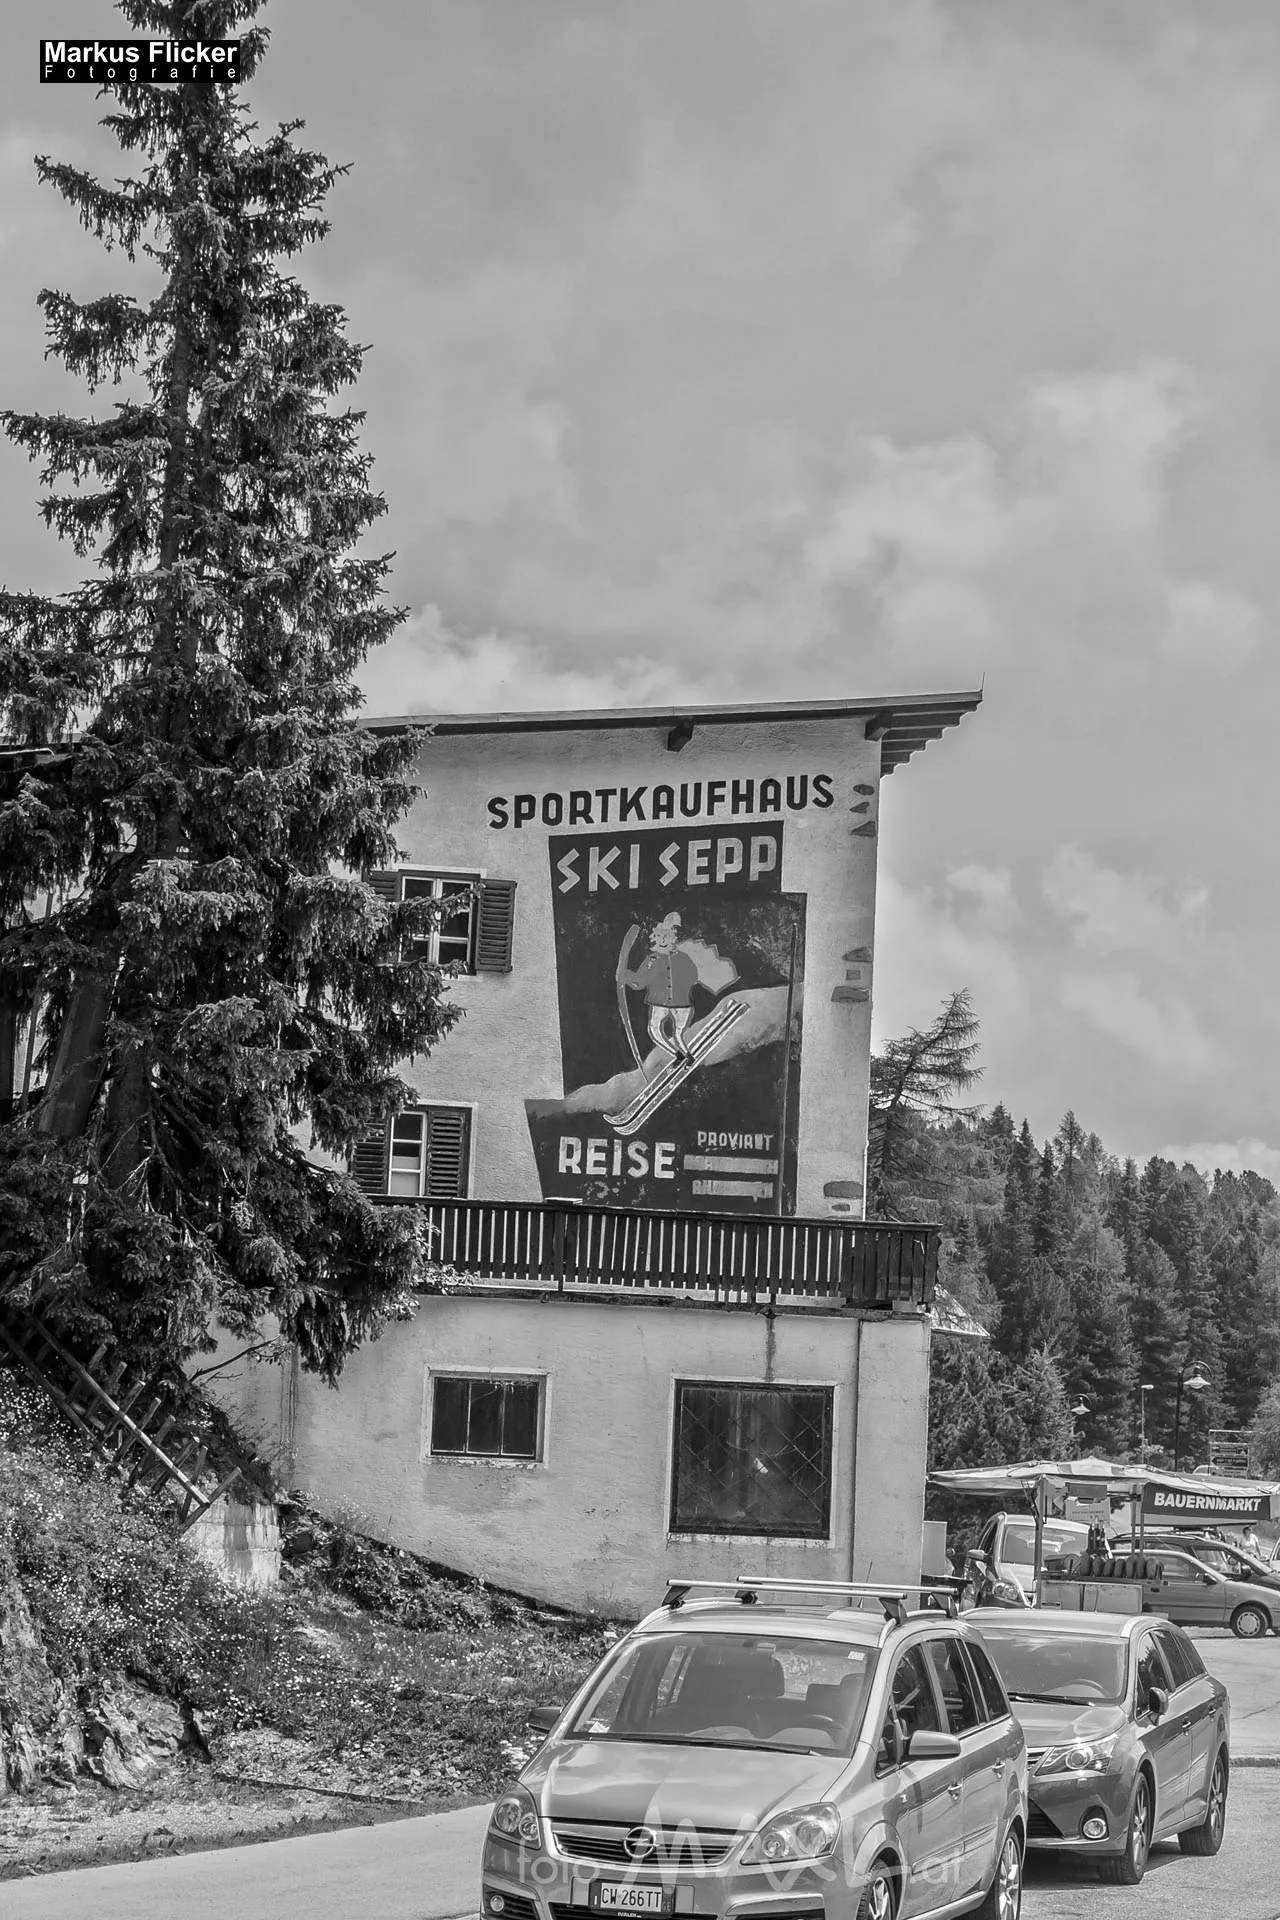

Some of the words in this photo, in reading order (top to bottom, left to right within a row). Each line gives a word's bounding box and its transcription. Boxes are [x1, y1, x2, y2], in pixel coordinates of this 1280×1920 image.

[487, 774, 834, 829] SPORTKAUFHAUS
[557, 844, 641, 894] SKI
[659, 836, 777, 887] SEPP
[558, 1136, 676, 1179] REISE
[1154, 1492, 1262, 1512] BAUERNMARKT
